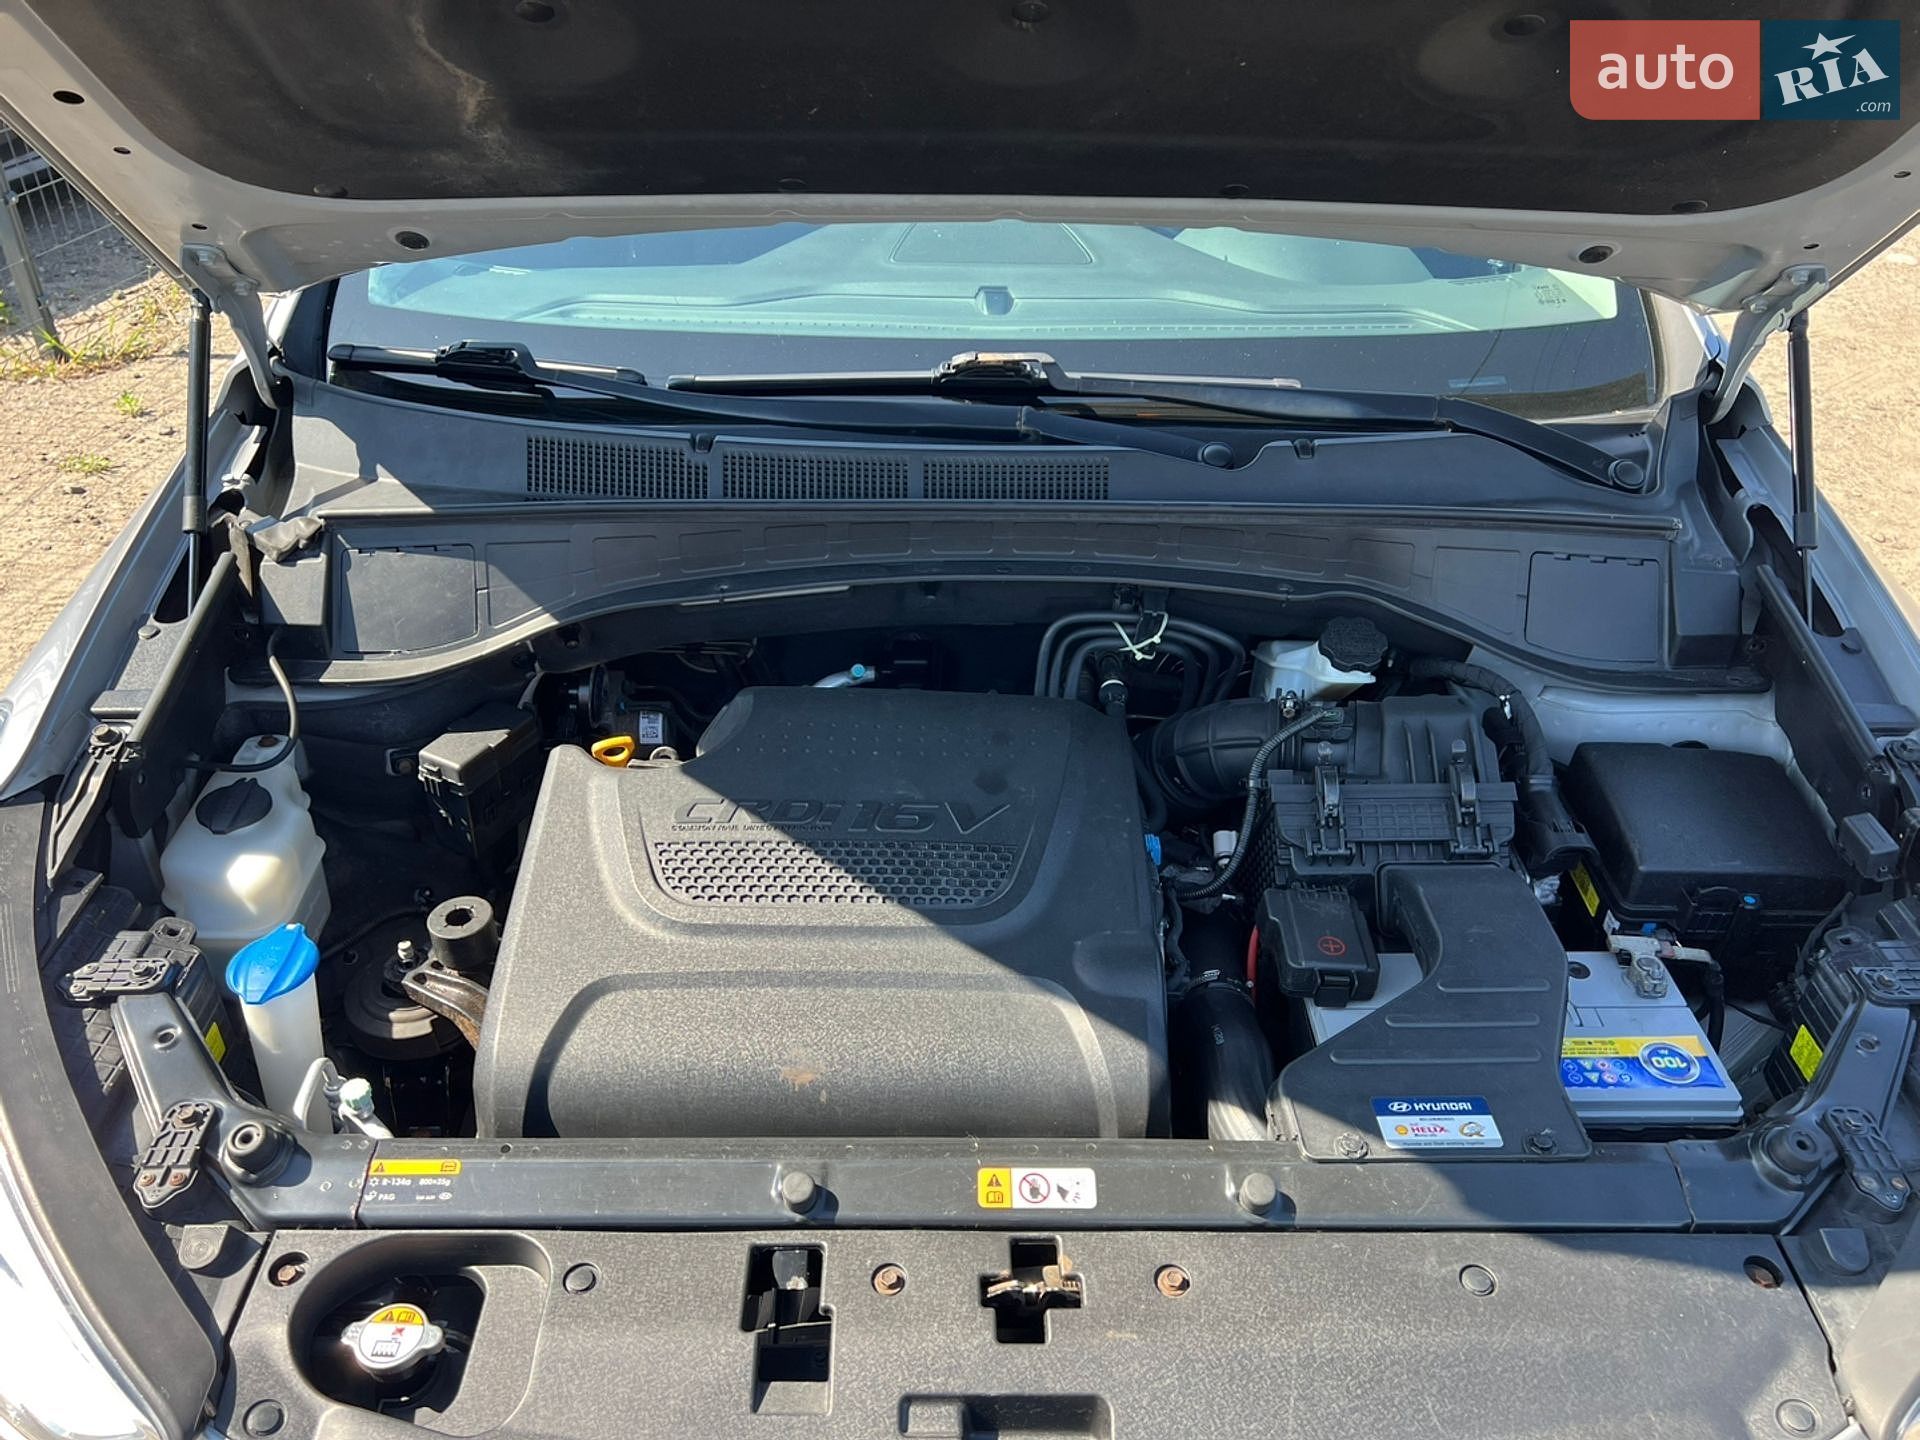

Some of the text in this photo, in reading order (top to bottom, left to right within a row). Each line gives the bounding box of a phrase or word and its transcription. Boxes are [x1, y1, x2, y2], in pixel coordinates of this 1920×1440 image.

[847, 800, 1011, 835] 16V
[1651, 1056, 1688, 1068] 100
[1413, 1102, 1473, 1111] HYUNDAI
[1411, 1126, 1448, 1134] HELIX
